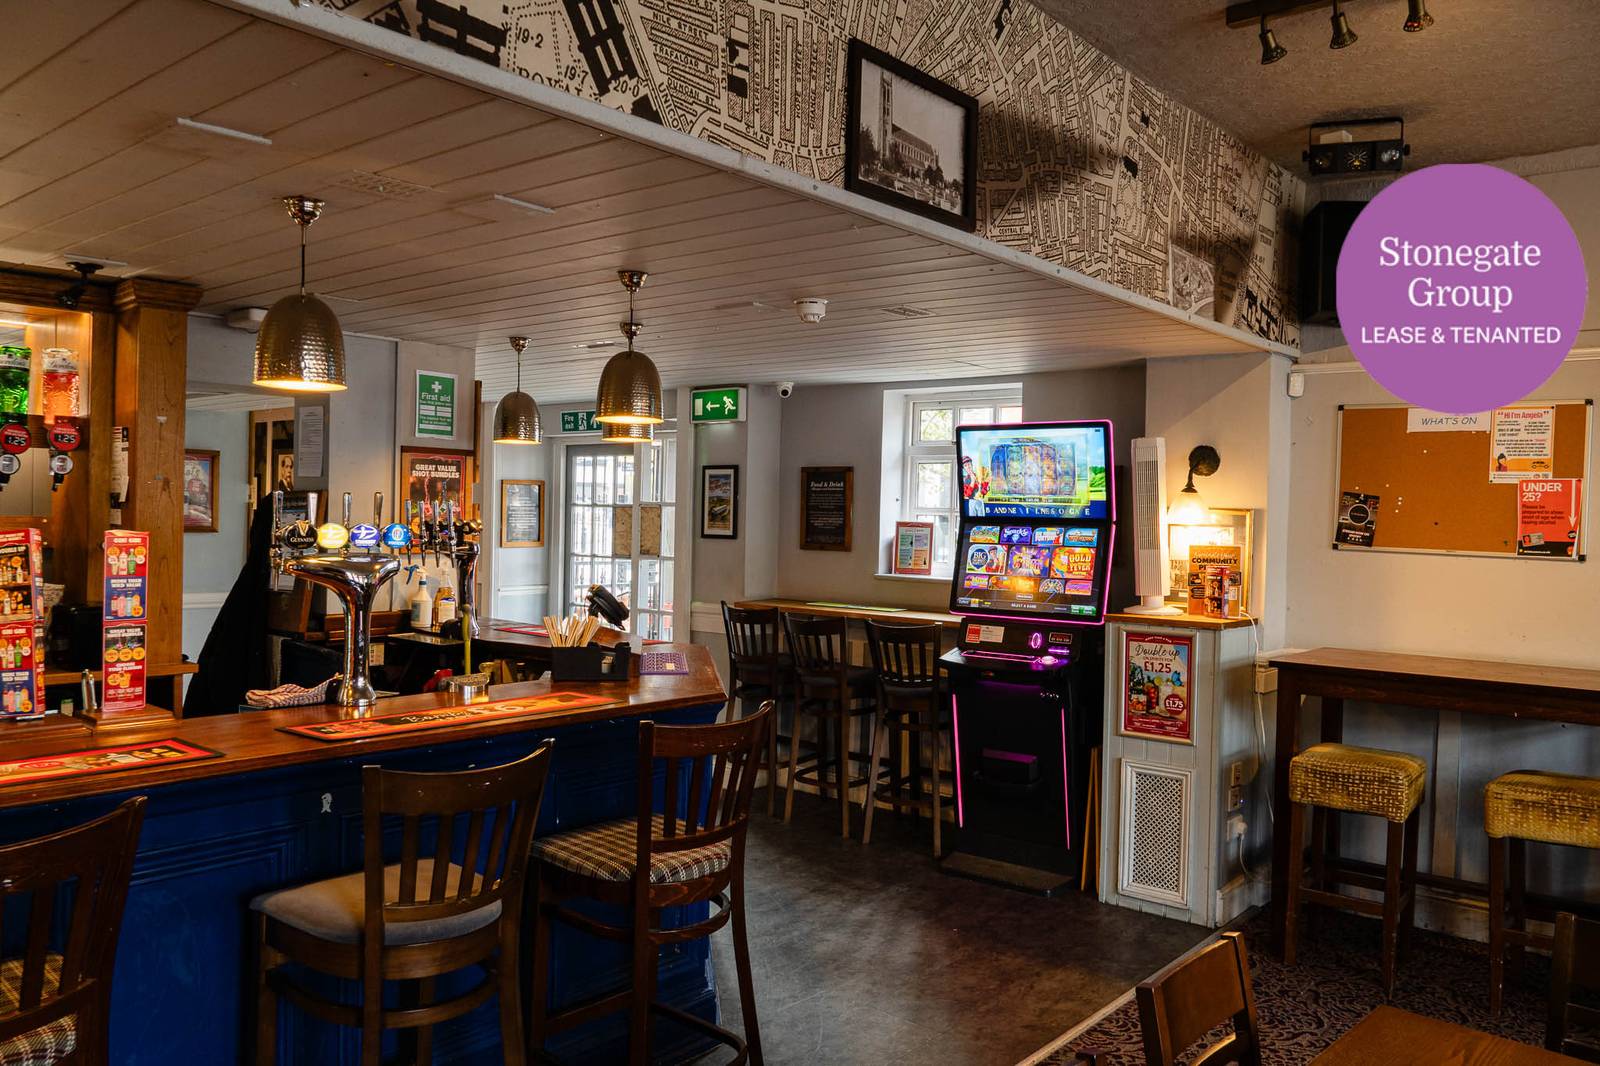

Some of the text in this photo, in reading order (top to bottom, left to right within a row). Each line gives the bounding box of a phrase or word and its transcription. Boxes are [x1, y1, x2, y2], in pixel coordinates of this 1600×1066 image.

[653, 12, 708, 40] NILE STREET
[653, 44, 698, 68] TRAFALGAR
[745, 125, 840, 156] CHARLOTTE STREET
[422, 392, 438, 400] First
[1461, 416, 1478, 425] ON
[1522, 482, 1562, 492] UNDER
[1522, 492, 1542, 502] 25?
[1068, 552, 1092, 562] GOLD
[1136, 644, 1180, 660] Double up
[1144, 660, 1172, 674] £1.25
[1166, 700, 1184, 708] £1.75
